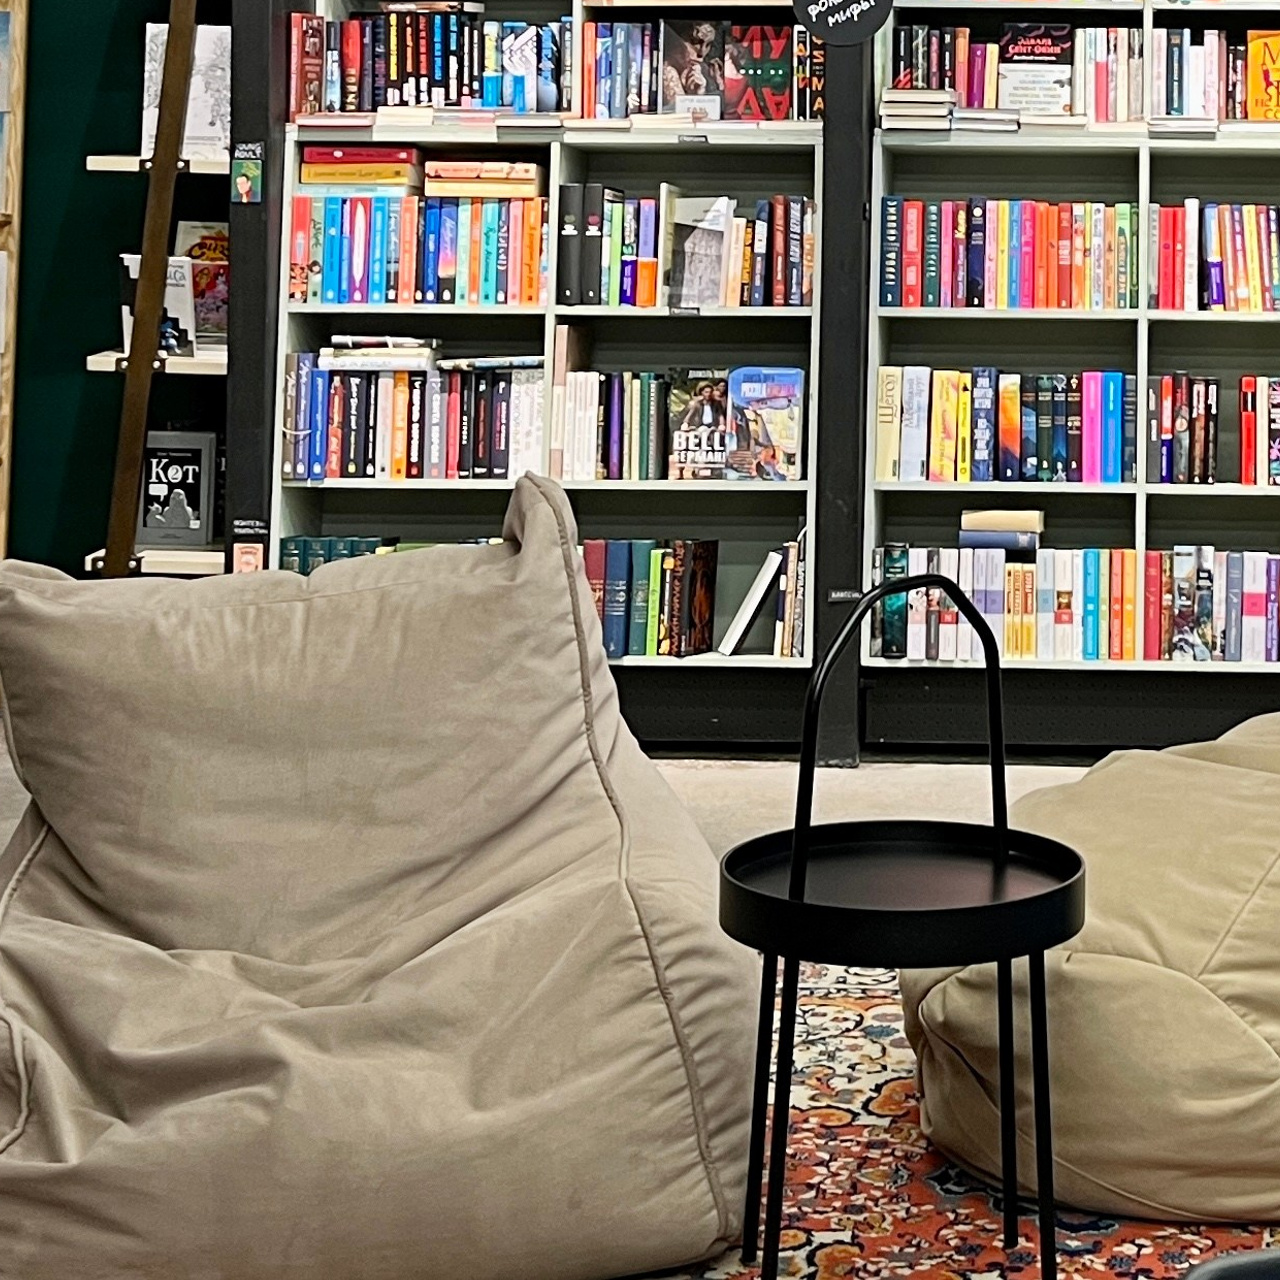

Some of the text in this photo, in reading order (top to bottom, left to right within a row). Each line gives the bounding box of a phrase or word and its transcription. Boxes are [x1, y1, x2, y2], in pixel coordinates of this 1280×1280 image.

[430, 393, 440, 423] СВИТА
[878, 374, 898, 424] Щегол
[673, 431, 725, 450] BELL
[673, 450, 727, 464] ГЕРМАН
